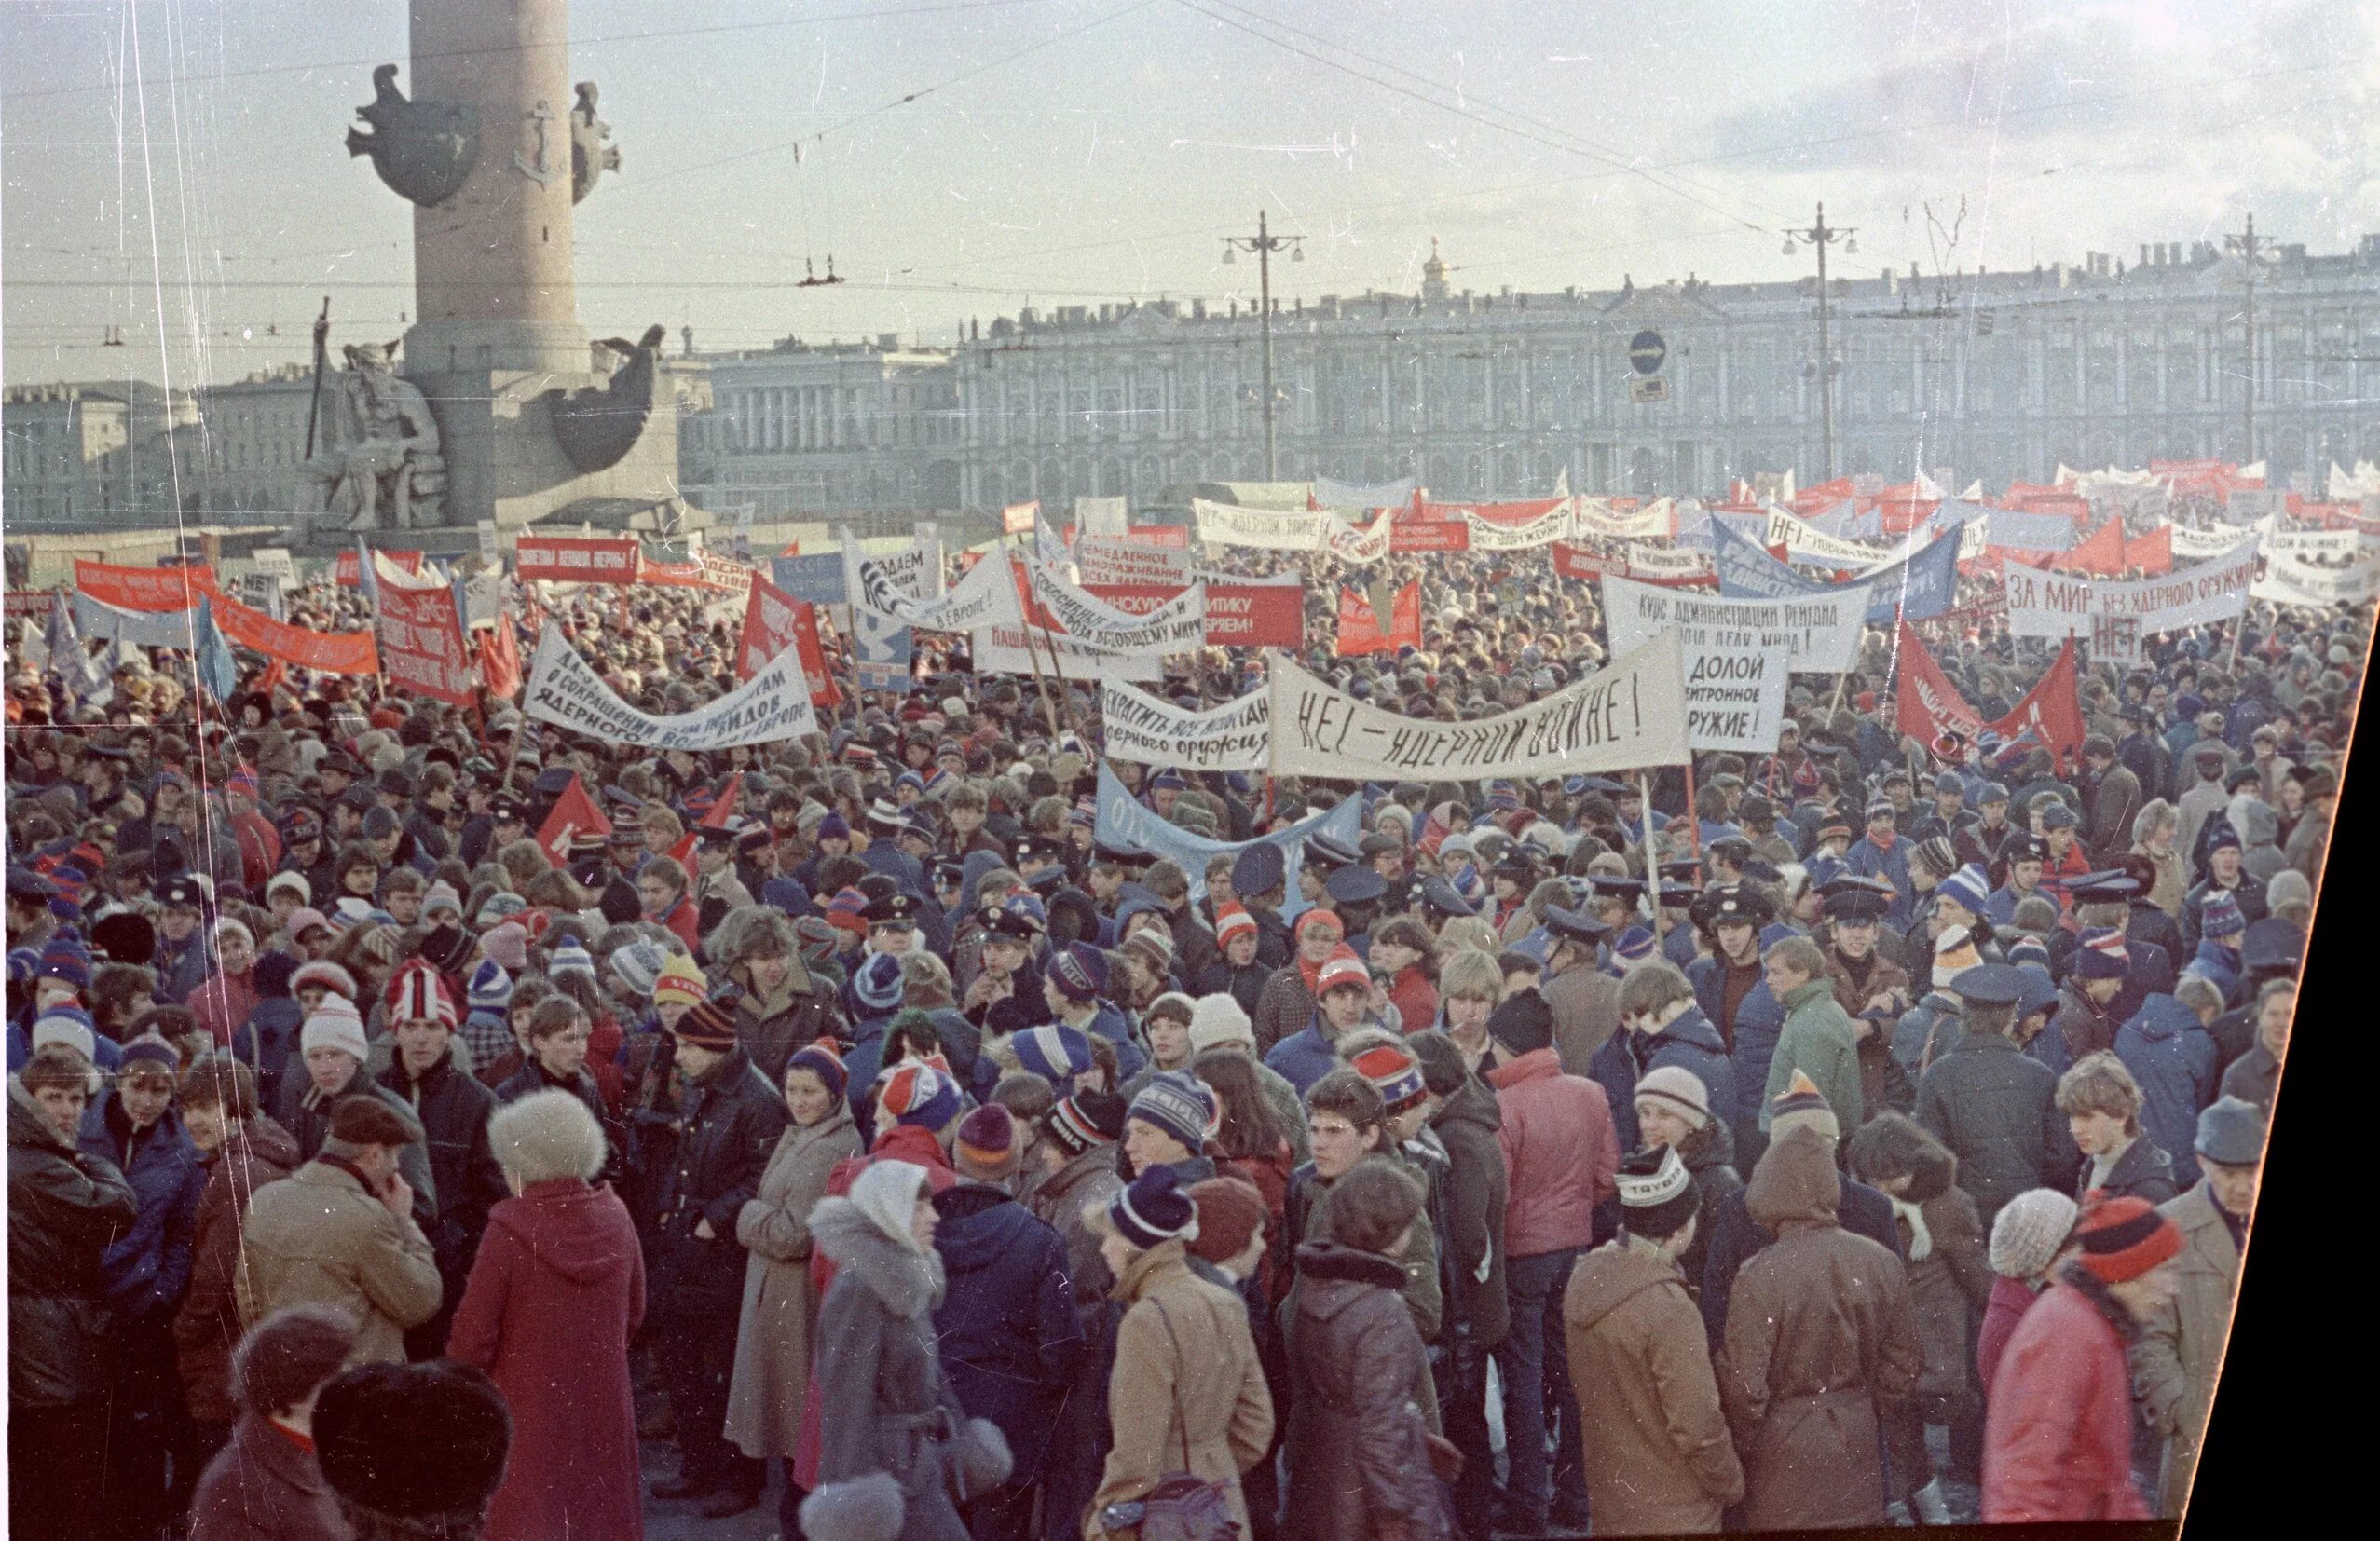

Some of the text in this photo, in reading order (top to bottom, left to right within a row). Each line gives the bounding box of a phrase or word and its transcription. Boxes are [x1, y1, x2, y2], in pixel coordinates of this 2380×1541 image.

[1638, 593, 1668, 621] КУРС
[1674, 604, 1778, 627] АДМИНИСТРАЦИИ
[2009, 574, 2037, 609] ЗА
[2045, 581, 2094, 613] МИР
[2103, 593, 2126, 613] БЕЗ
[2093, 616, 2137, 658] НЕТ
[1689, 652, 1765, 683] ДОЛОЙ
[533, 687, 641, 743] ЯДЕРНОГО
